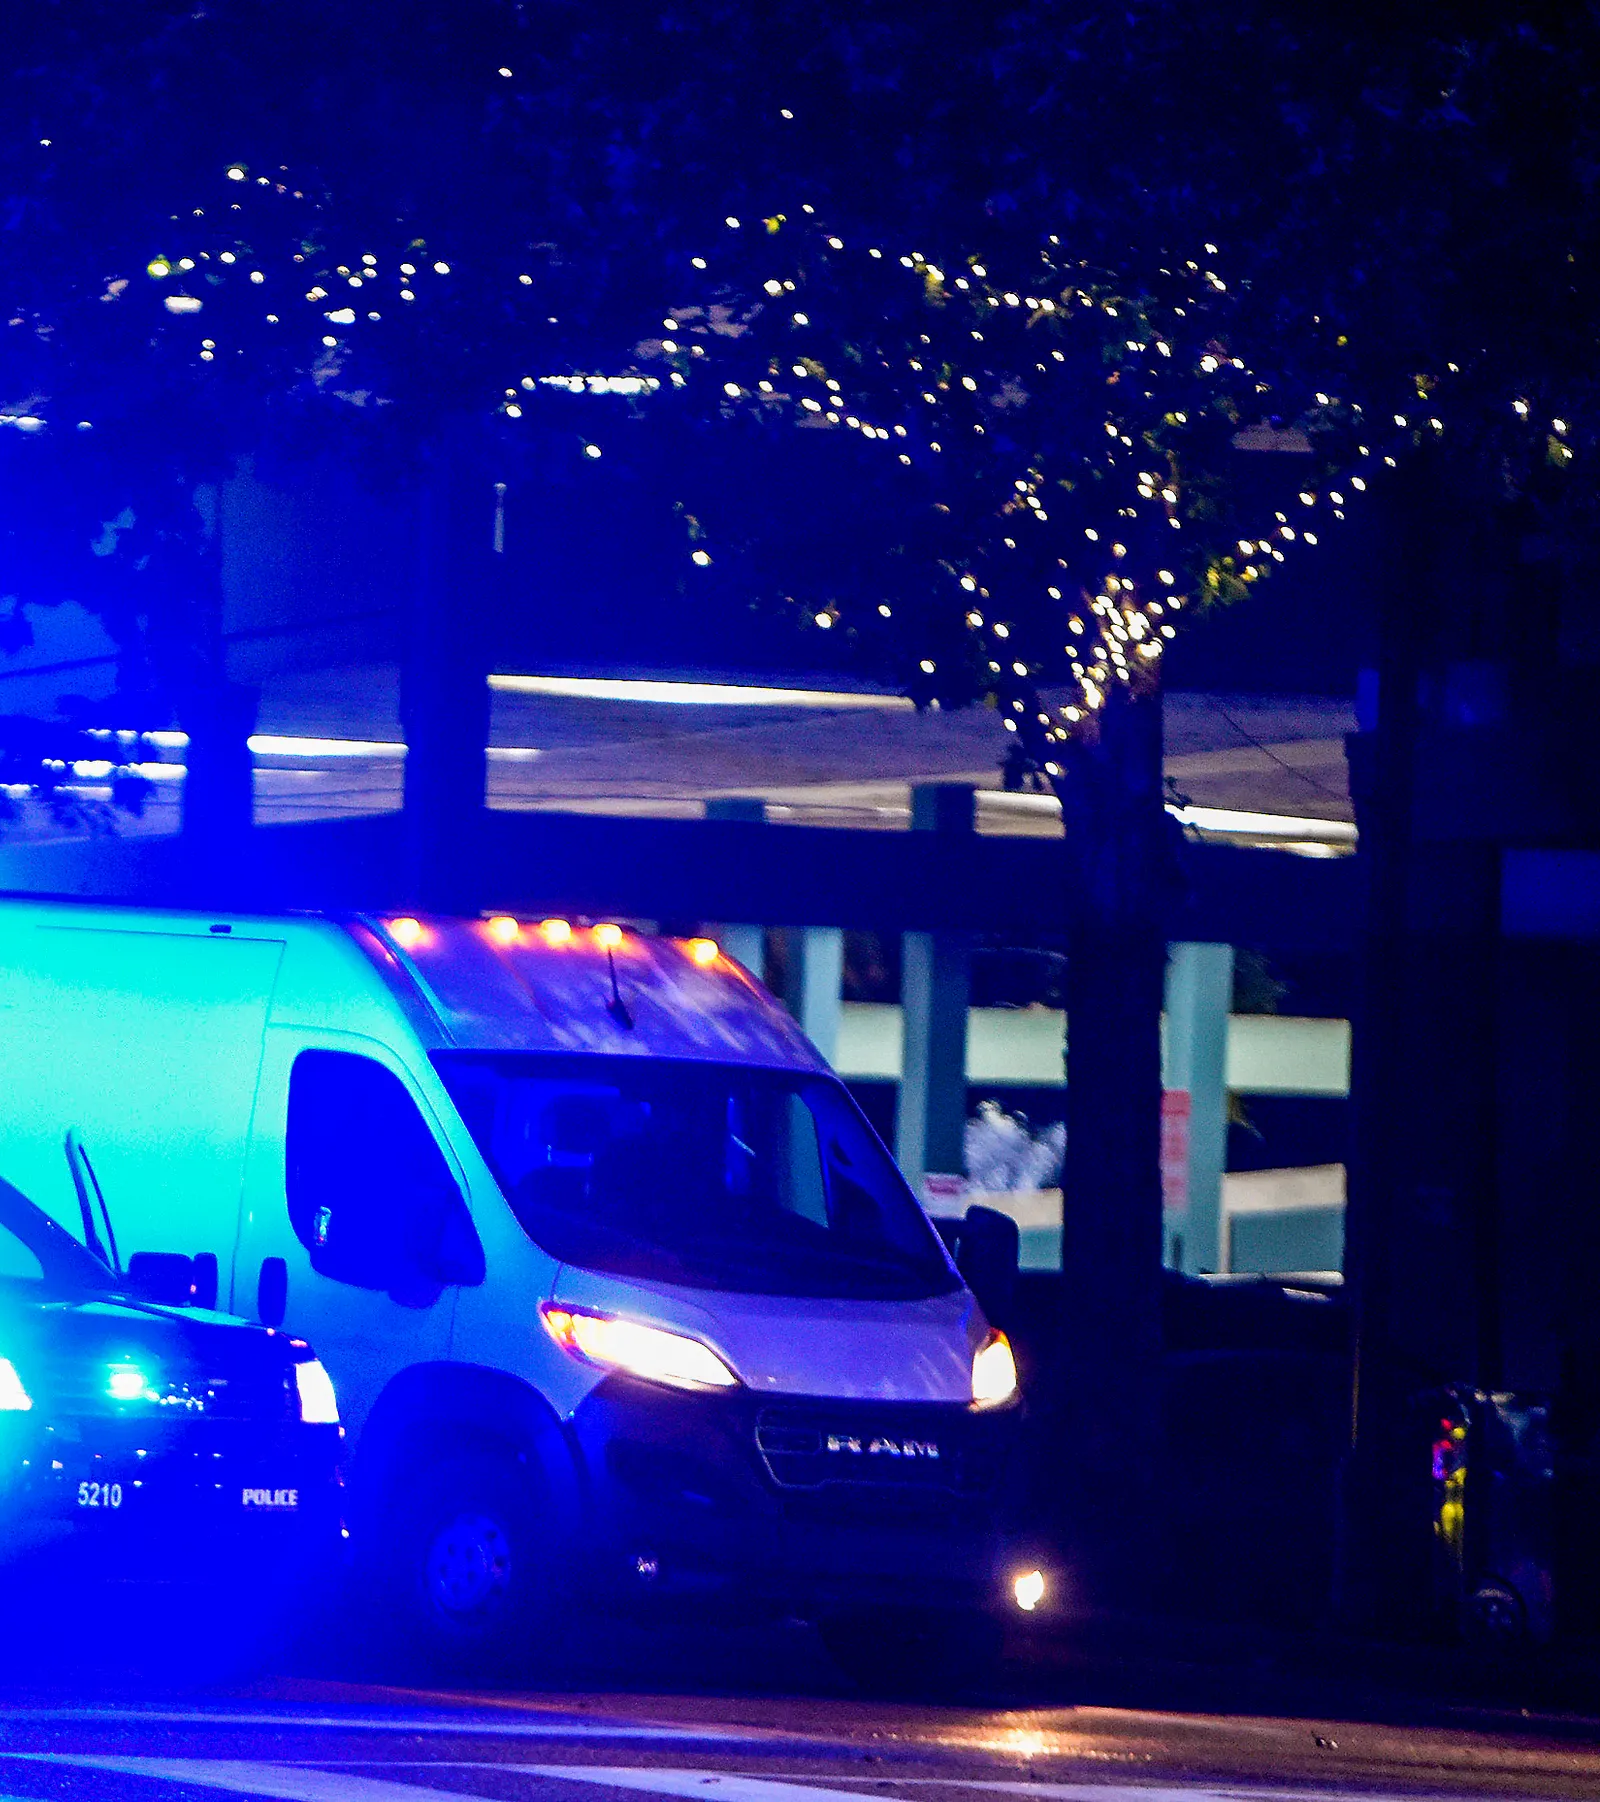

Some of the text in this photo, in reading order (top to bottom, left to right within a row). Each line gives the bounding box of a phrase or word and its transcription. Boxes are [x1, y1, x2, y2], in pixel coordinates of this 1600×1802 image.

[827, 1434, 940, 1457] RAM
[77, 1481, 122, 1507] 5210
[242, 1488, 298, 1505] POLICE
